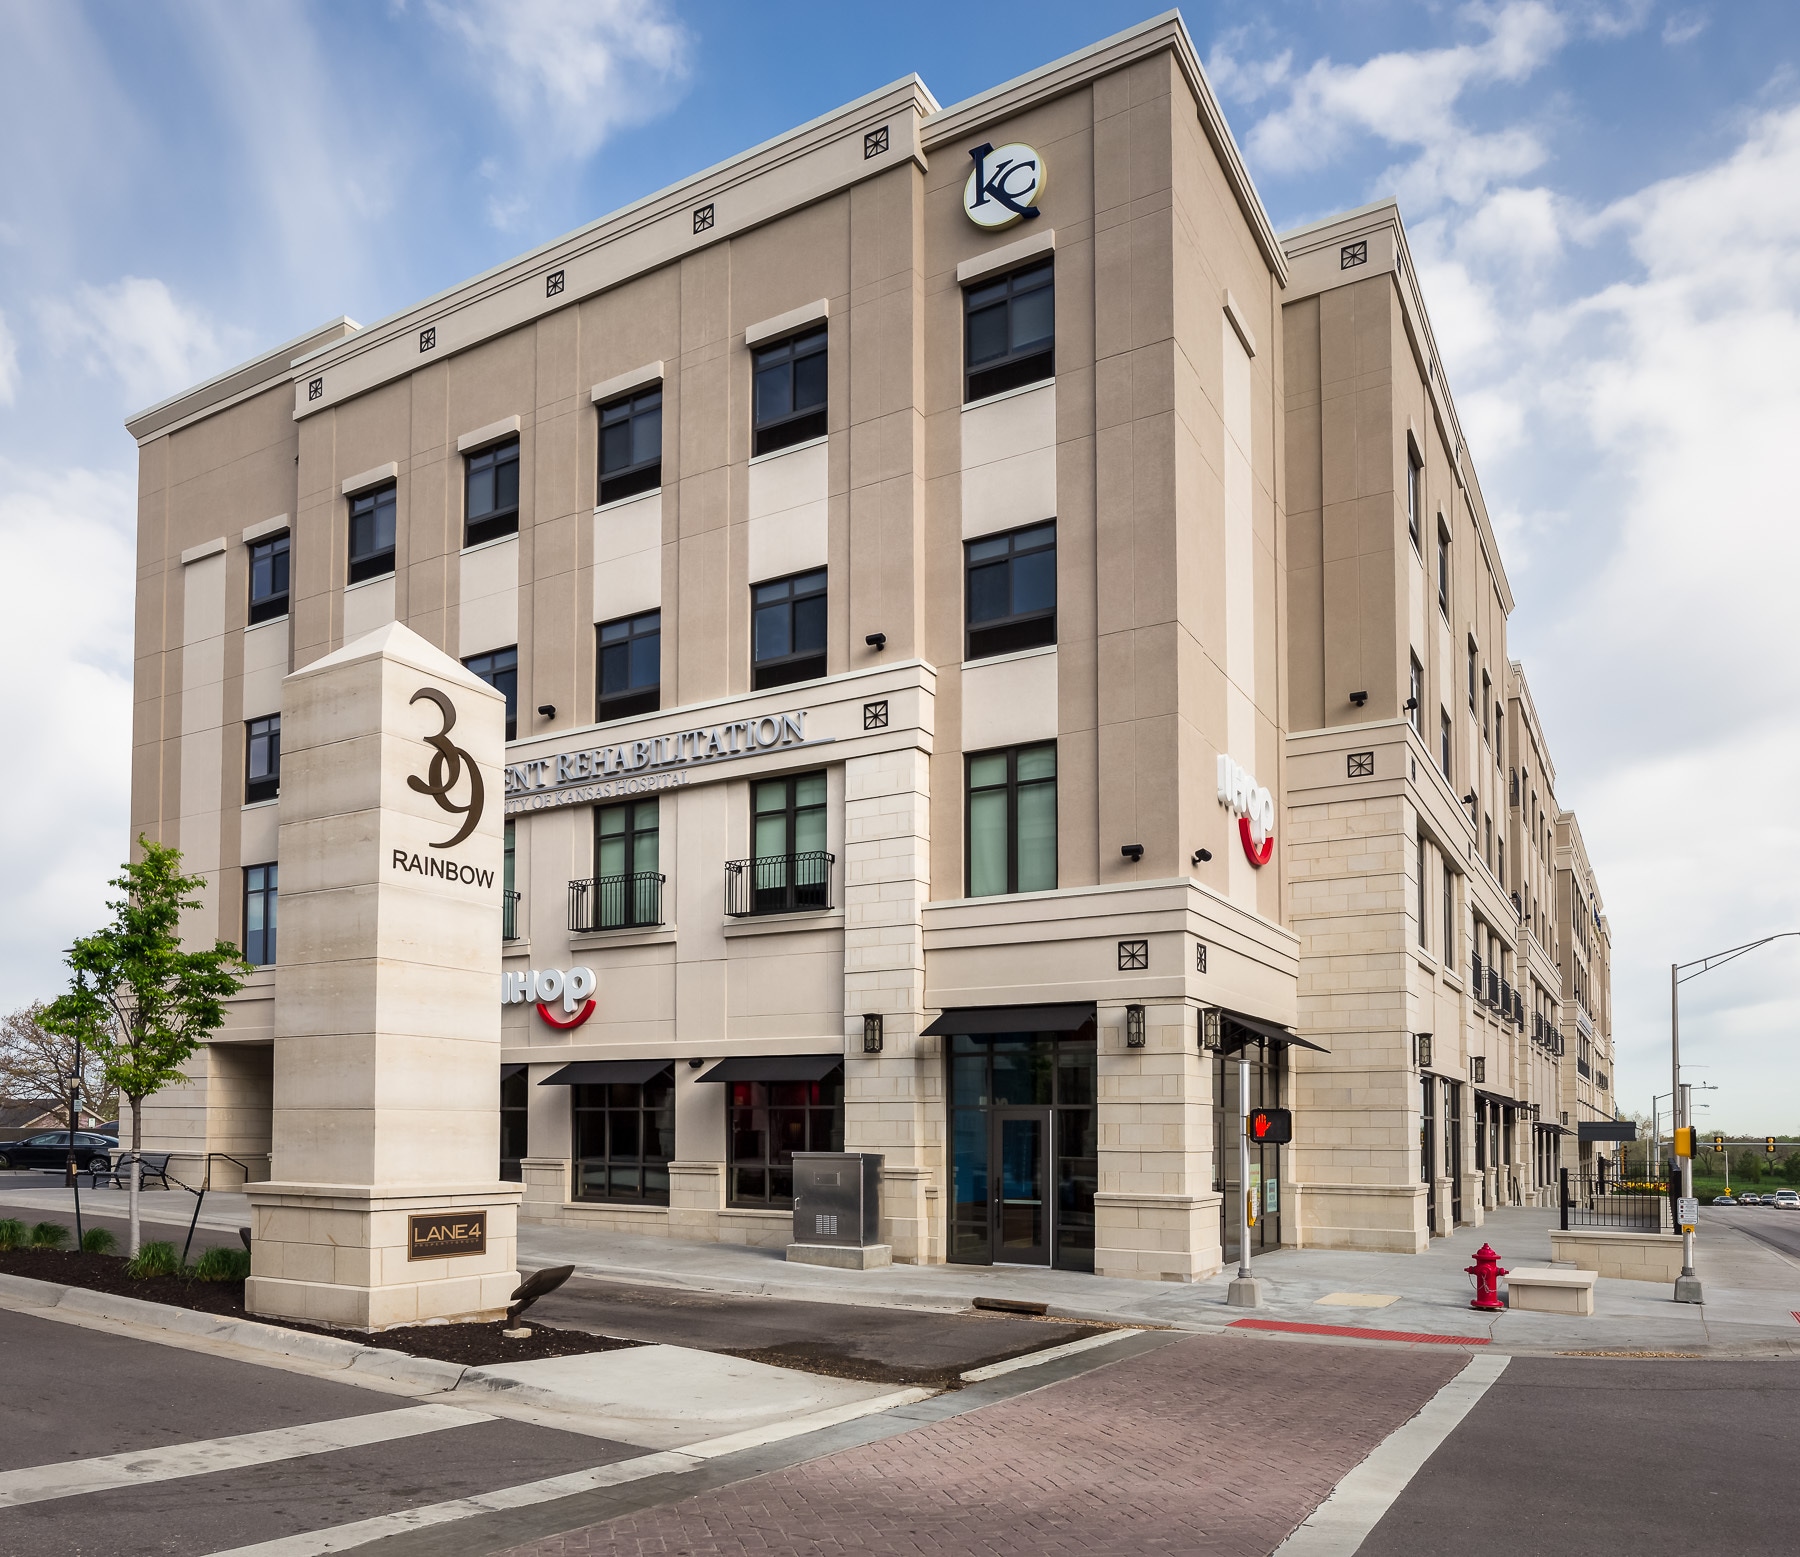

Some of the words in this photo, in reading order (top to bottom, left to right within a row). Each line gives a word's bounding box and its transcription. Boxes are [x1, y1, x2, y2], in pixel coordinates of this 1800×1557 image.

[407, 687, 485, 849] 39
[555, 711, 808, 783] REHABILITATION
[532, 794, 551, 809] OF
[554, 783, 613, 807] KANSAS
[615, 770, 690, 797] HOSPITAL
[392, 849, 495, 889] RAINBOW
